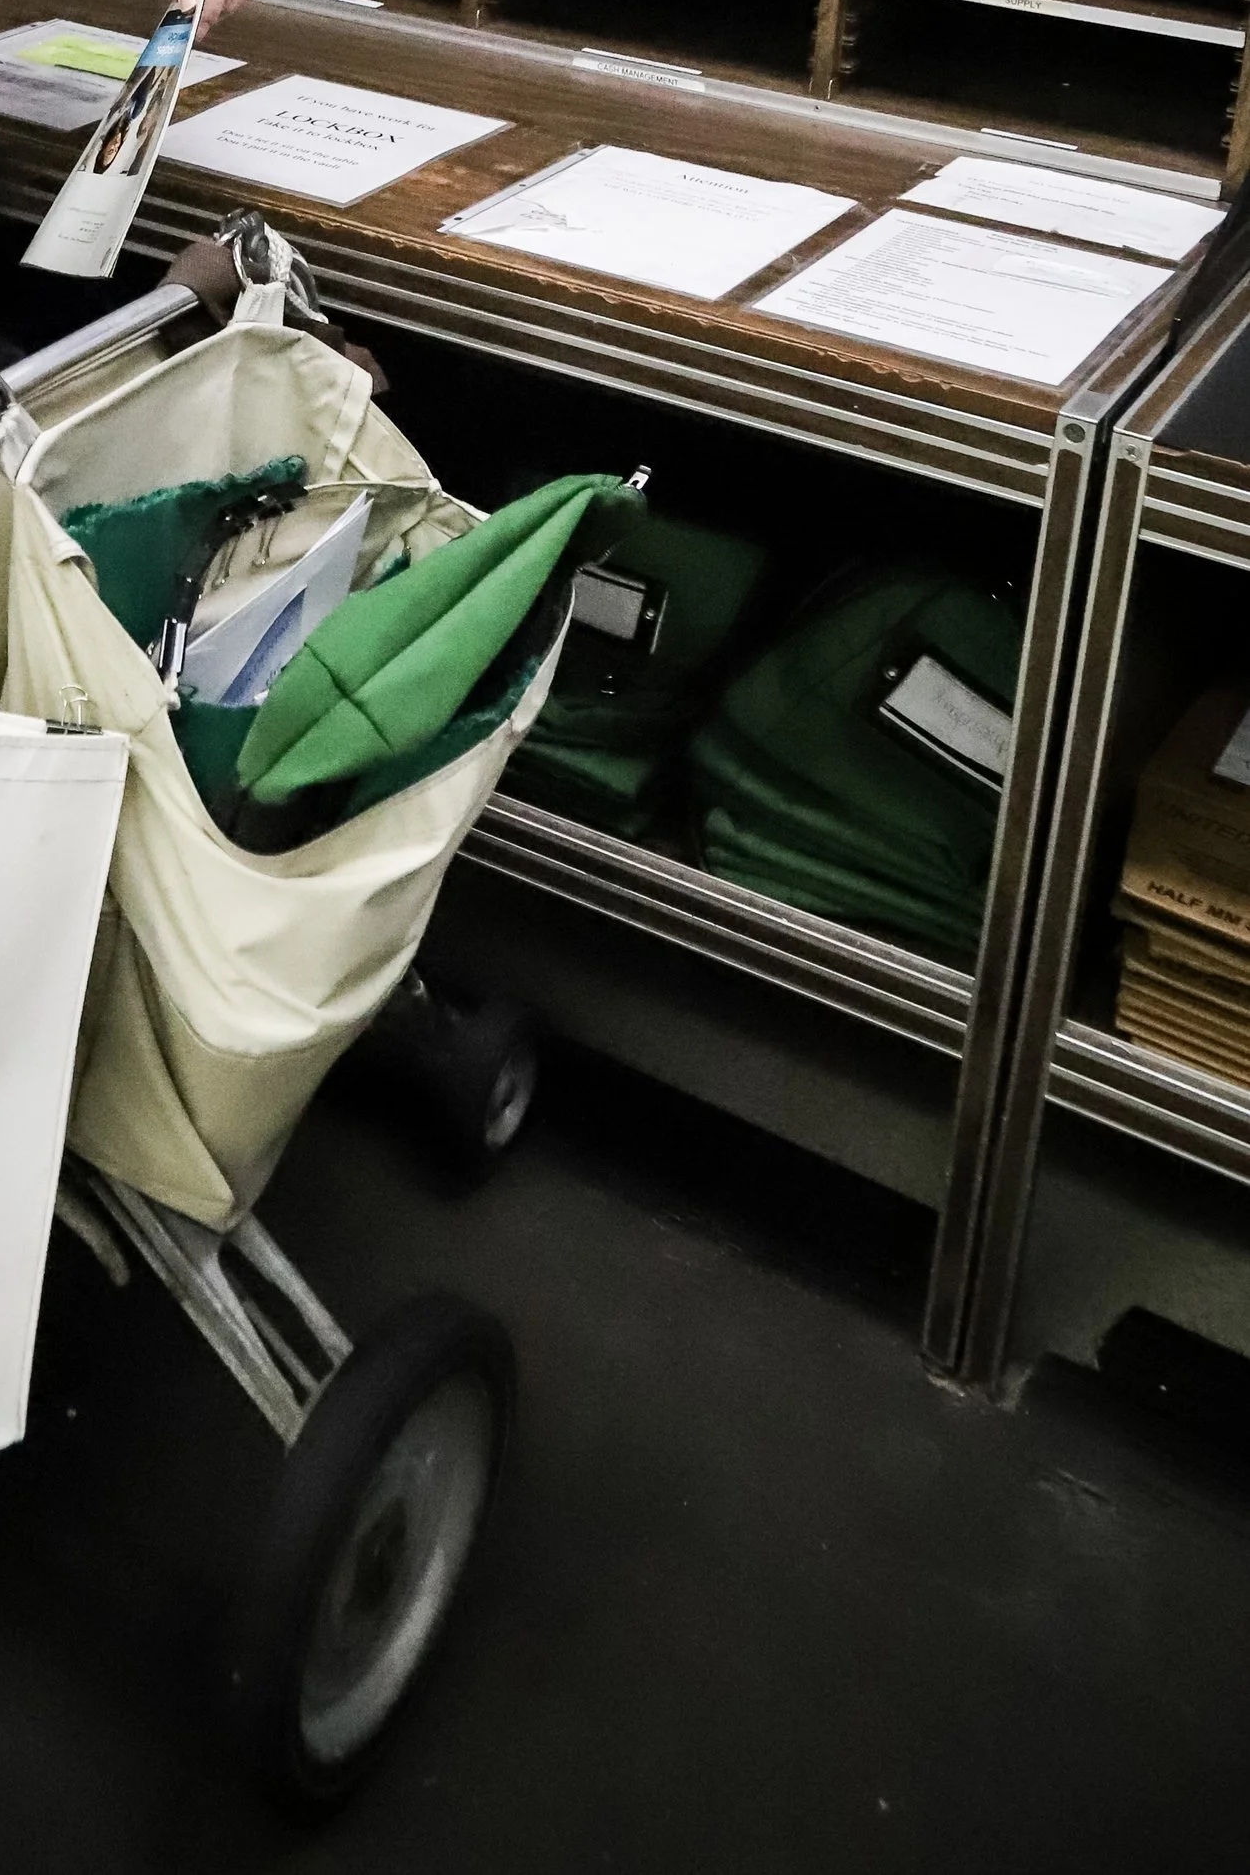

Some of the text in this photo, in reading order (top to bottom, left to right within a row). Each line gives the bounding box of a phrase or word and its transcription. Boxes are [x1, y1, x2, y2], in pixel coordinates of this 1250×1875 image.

[597, 62, 679, 86] CASH MANAGEMENT
[275, 110, 404, 143] LOCKBOX
[310, 99, 337, 110] you
[341, 106, 374, 117] have
[378, 115, 411, 125] work
[416, 123, 436, 132] for
[256, 118, 290, 130] Take
[323, 134, 379, 151] lockbox
[312, 151, 330, 159] the
[683, 174, 749, 194] Attention
[1146, 880, 1243, 925] HALF MM
